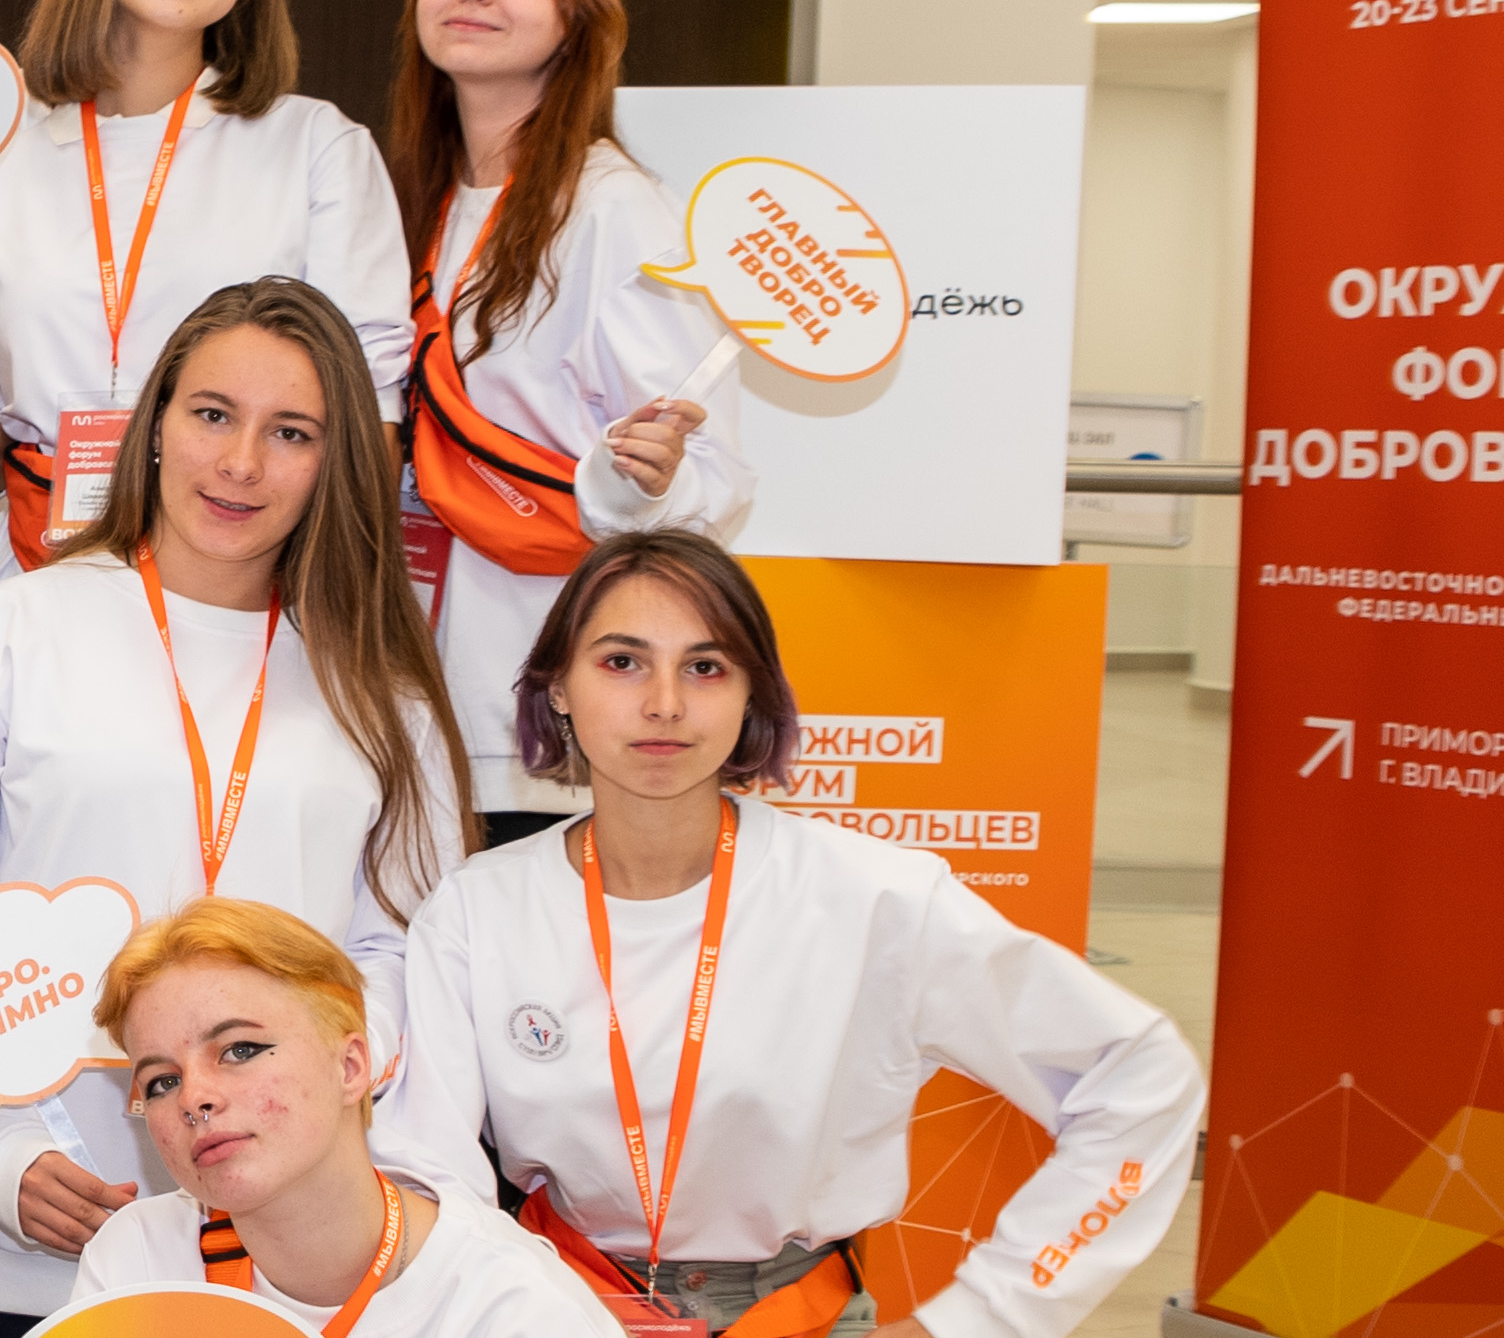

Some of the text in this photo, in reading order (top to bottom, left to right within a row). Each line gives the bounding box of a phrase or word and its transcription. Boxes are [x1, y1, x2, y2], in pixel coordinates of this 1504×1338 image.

[726, 239, 831, 347] ТВОРЕЦ
[744, 227, 844, 319] ДОБРО
[746, 187, 881, 317] ГЛАВНЫЙ
[1328, 263, 1504, 320] ОКРУ
[1391, 345, 1504, 402] ФО
[216, 770, 247, 863] #МЫВМЕСТЕ
[689, 944, 719, 1043] #МЫВМЕСТЕ
[373, 1181, 398, 1277] #МЫВМЕСТЕ
